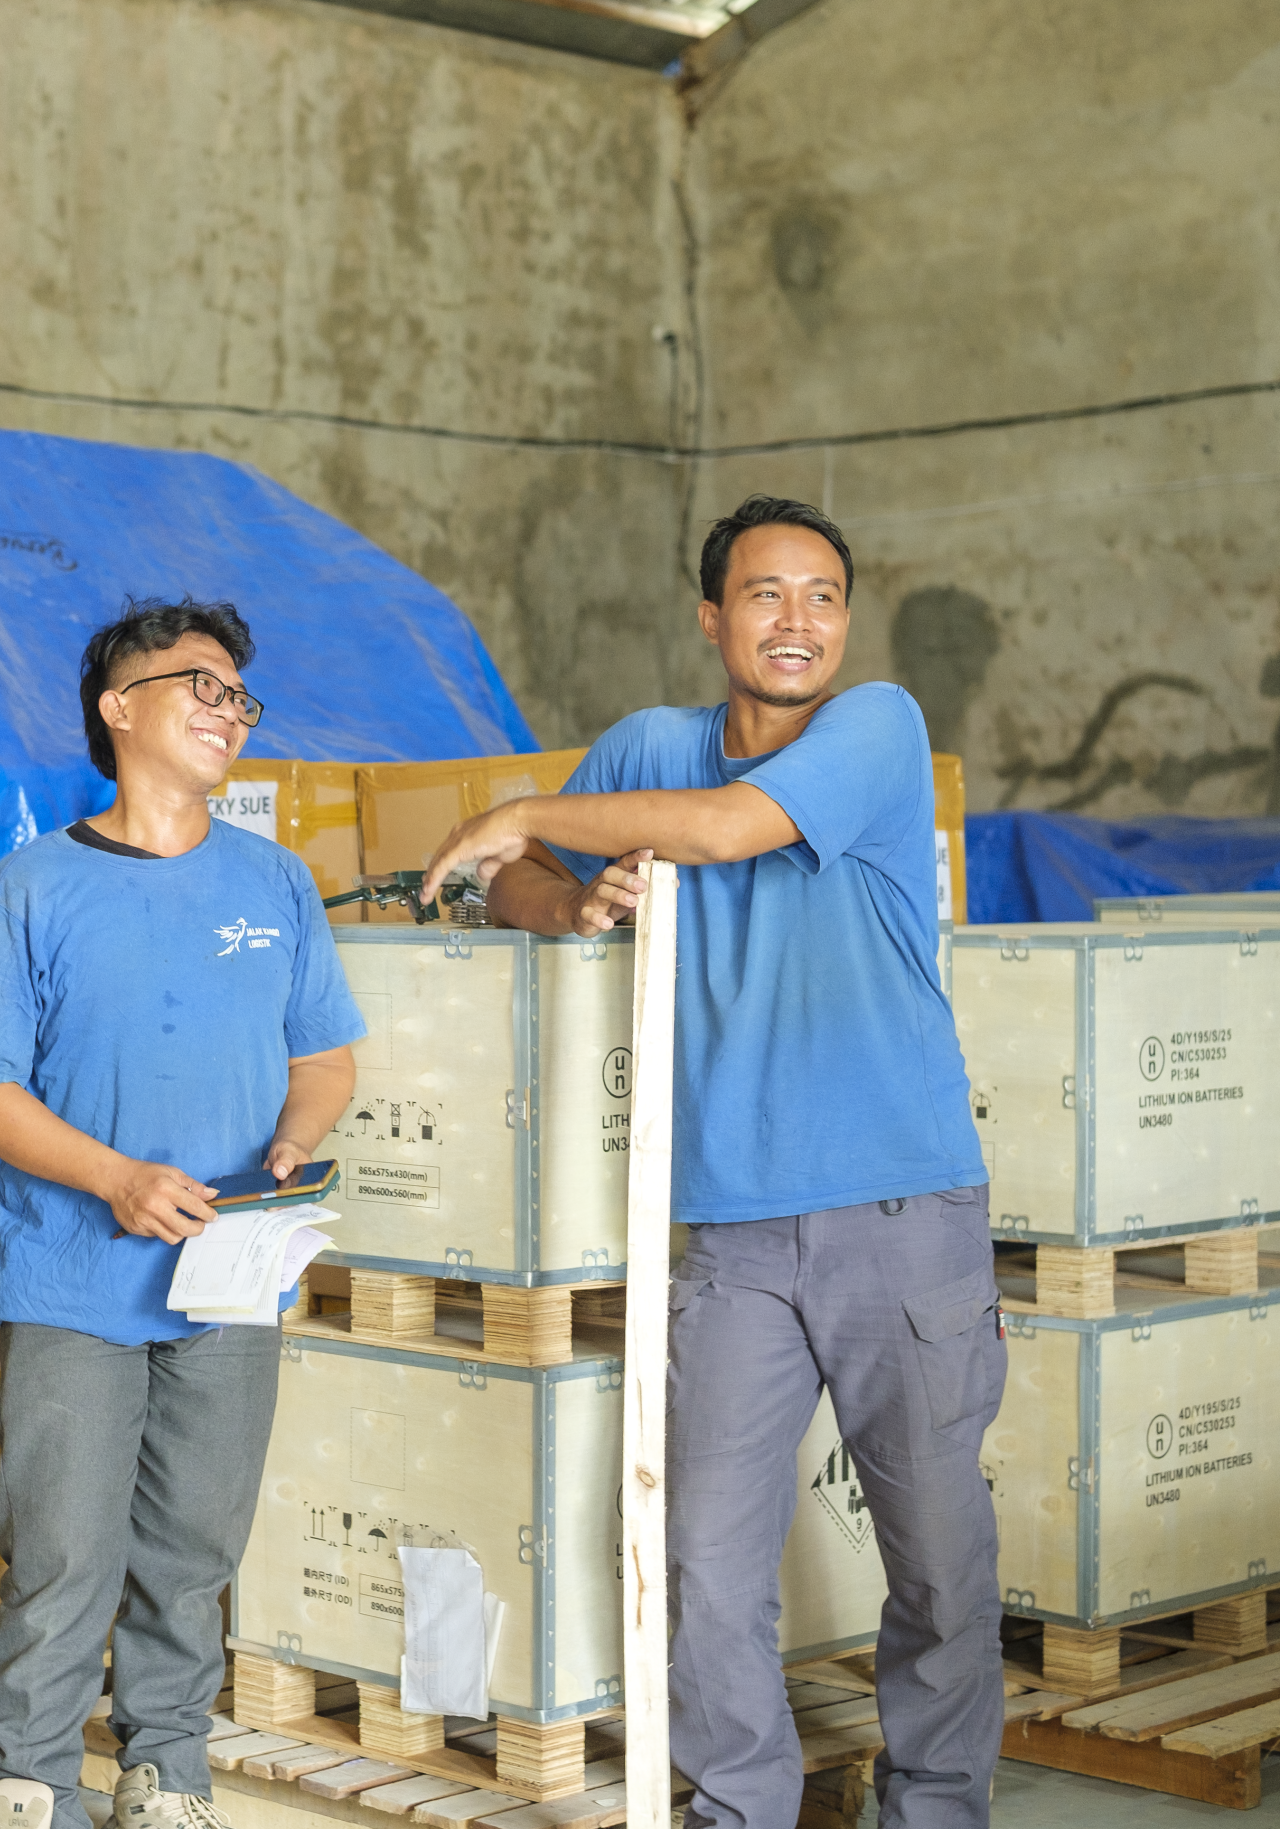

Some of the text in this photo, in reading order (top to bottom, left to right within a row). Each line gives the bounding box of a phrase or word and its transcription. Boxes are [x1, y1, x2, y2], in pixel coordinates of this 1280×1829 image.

[207, 796, 270, 815] CKY SUE
[248, 939, 271, 949] LOGISTIK
[1171, 1028, 1232, 1045] 4D/Y195/S/25
[1170, 1047, 1227, 1064] CN/C530253
[1171, 1067, 1200, 1082] PI:364
[1139, 1086, 1243, 1108] LITHIUM ION BATTERIES
[602, 1113, 630, 1129] LITH
[1139, 1113, 1173, 1129] UN3480
[602, 1136, 630, 1152] UN3
[358, 1166, 428, 1182] 865x575x430(mm)
[358, 1185, 428, 1202] 890x600x560(mm)
[1179, 1396, 1241, 1420] 4D/Y195/S/25
[1178, 1415, 1236, 1438] CN/C530253
[1178, 1438, 1209, 1457] PI:364
[1146, 1452, 1252, 1487] LITHIUM ION BATTERIES
[1146, 1488, 1180, 1507] UN3480
[334, 1574, 350, 1588] (ID)
[334, 1593, 353, 1607] (OD)
